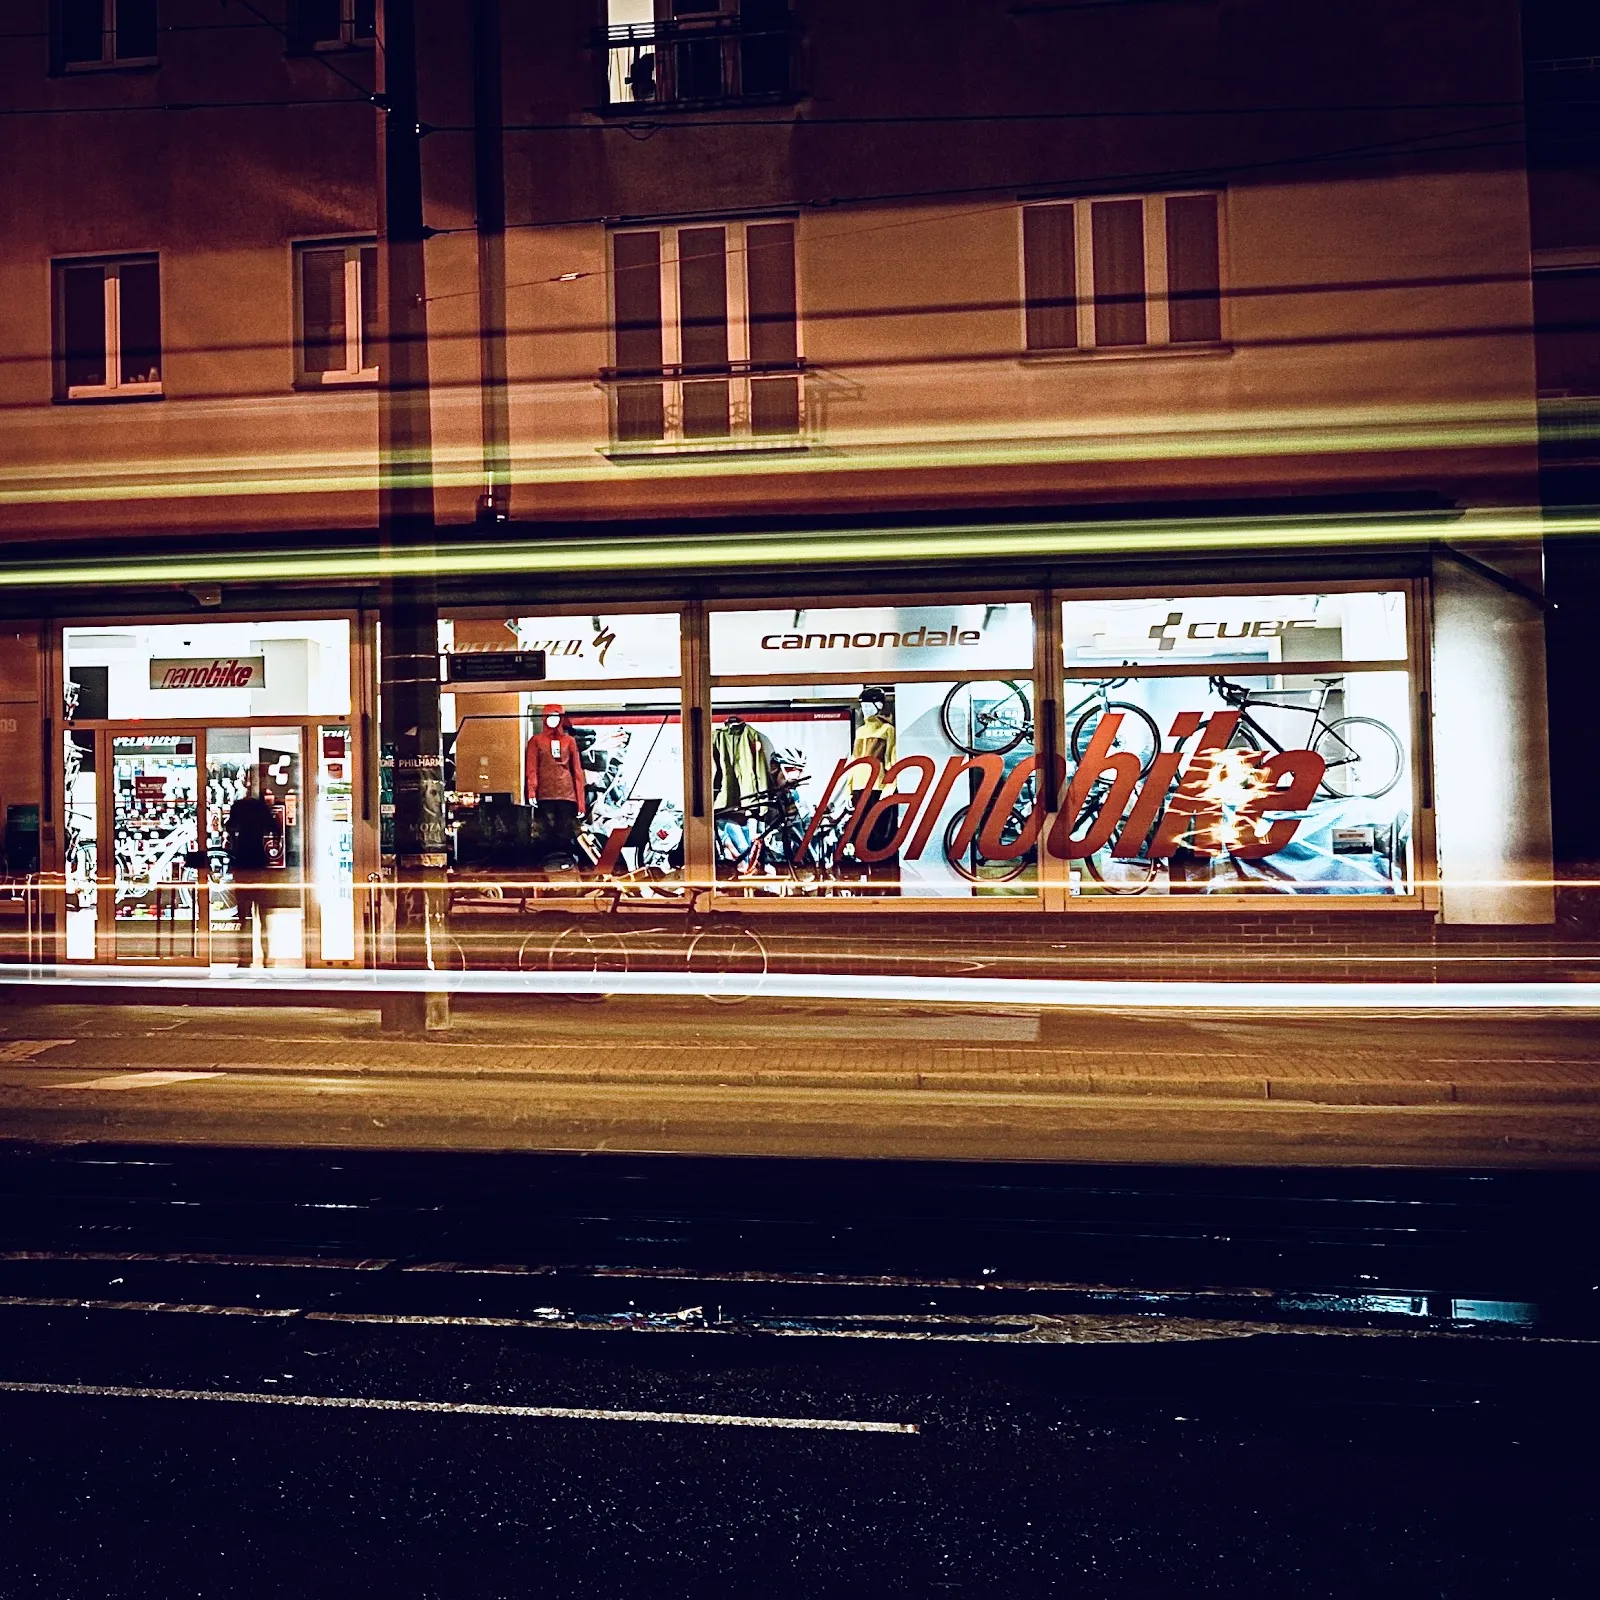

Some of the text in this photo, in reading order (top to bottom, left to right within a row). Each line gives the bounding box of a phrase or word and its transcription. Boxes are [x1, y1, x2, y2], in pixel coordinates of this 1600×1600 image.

[761, 625, 981, 650] cannondale
[161, 659, 254, 689] nanobike
[802, 711, 1326, 860] nanobike
